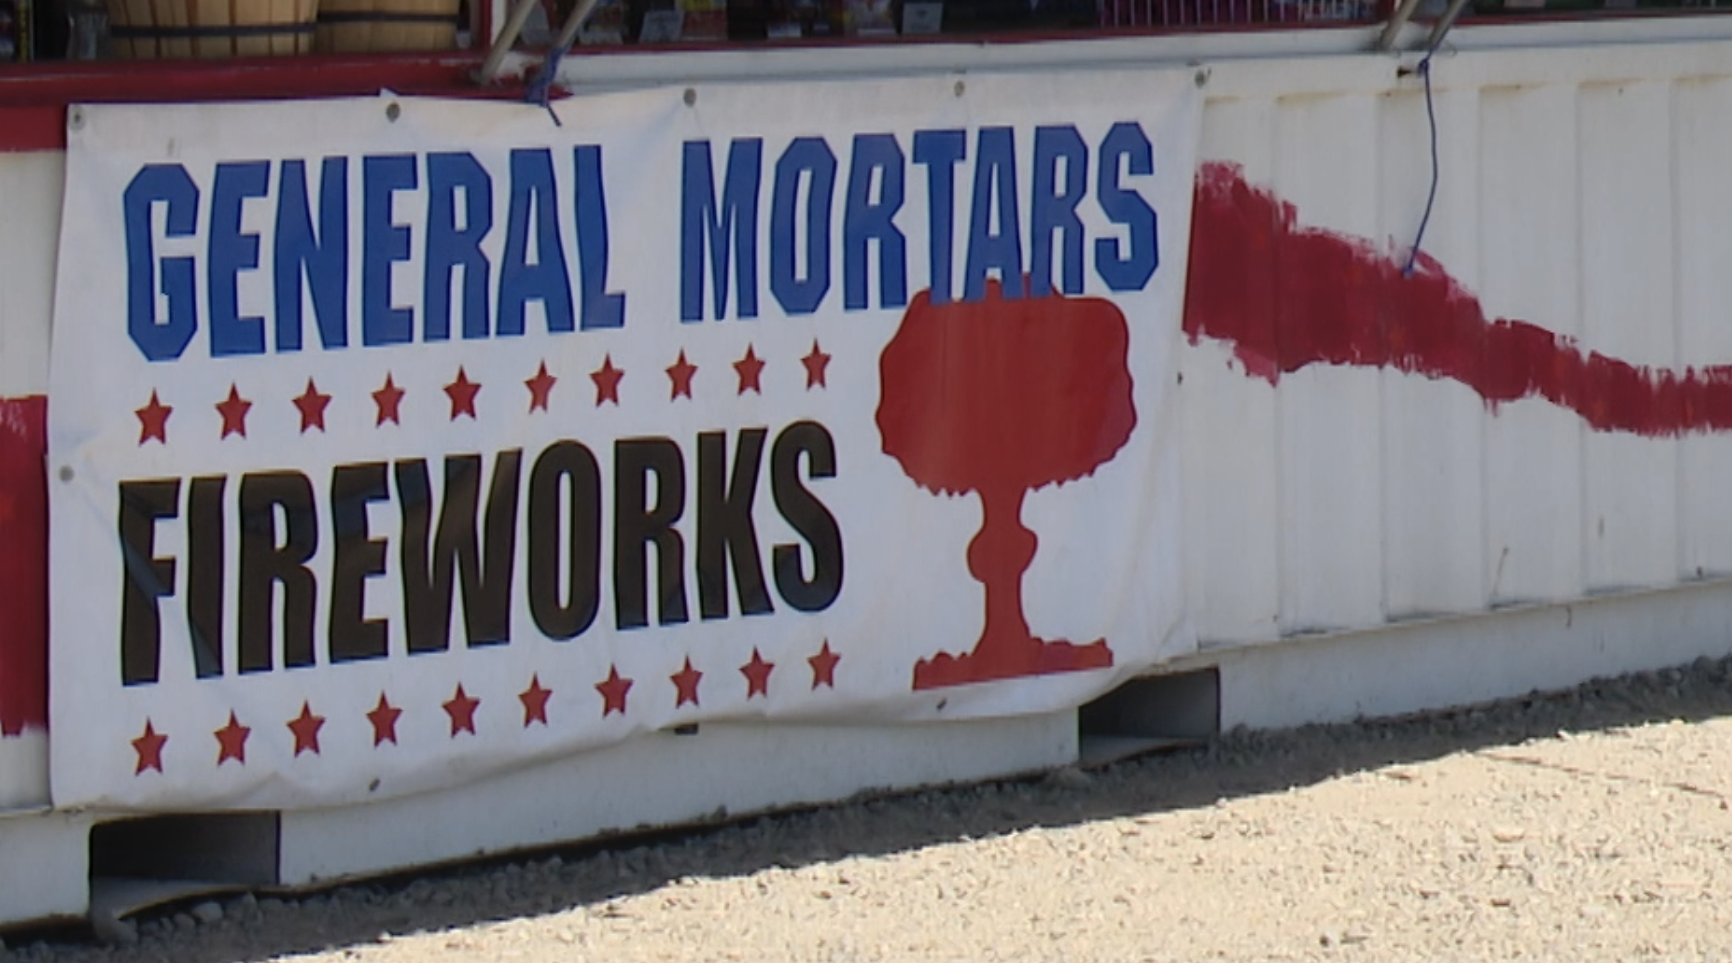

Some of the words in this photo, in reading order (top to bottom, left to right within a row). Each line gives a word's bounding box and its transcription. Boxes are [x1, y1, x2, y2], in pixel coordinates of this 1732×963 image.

[122, 144, 626, 362] GENERAL
[680, 121, 1160, 322] MORTARS
[119, 419, 845, 688] FIREWORKS
